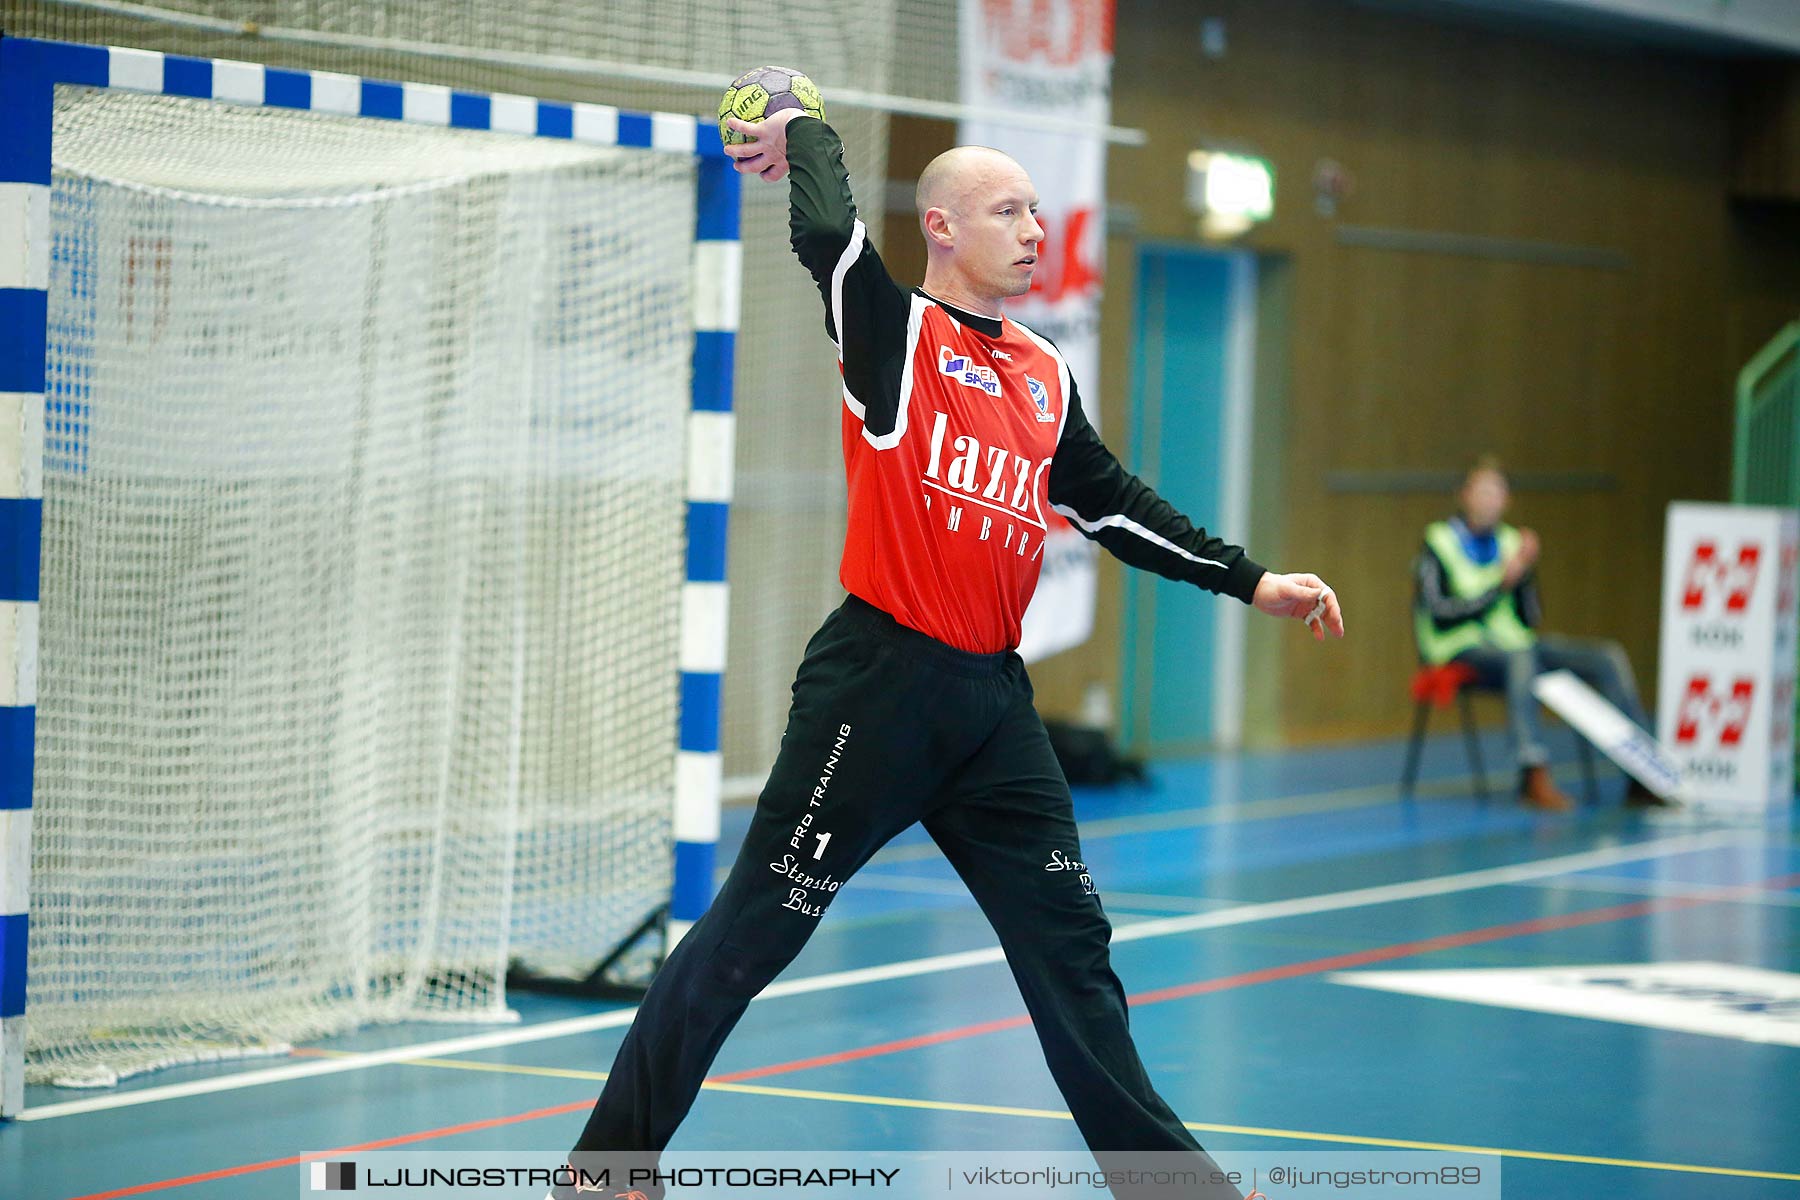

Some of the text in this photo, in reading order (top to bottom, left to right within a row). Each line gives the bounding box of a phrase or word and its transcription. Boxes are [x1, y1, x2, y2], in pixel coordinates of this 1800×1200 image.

[965, 372, 997, 393] SPRT
[790, 723, 852, 849] PRO TRAINING
[813, 832, 832, 860] 1
[769, 854, 844, 892] Stensto
